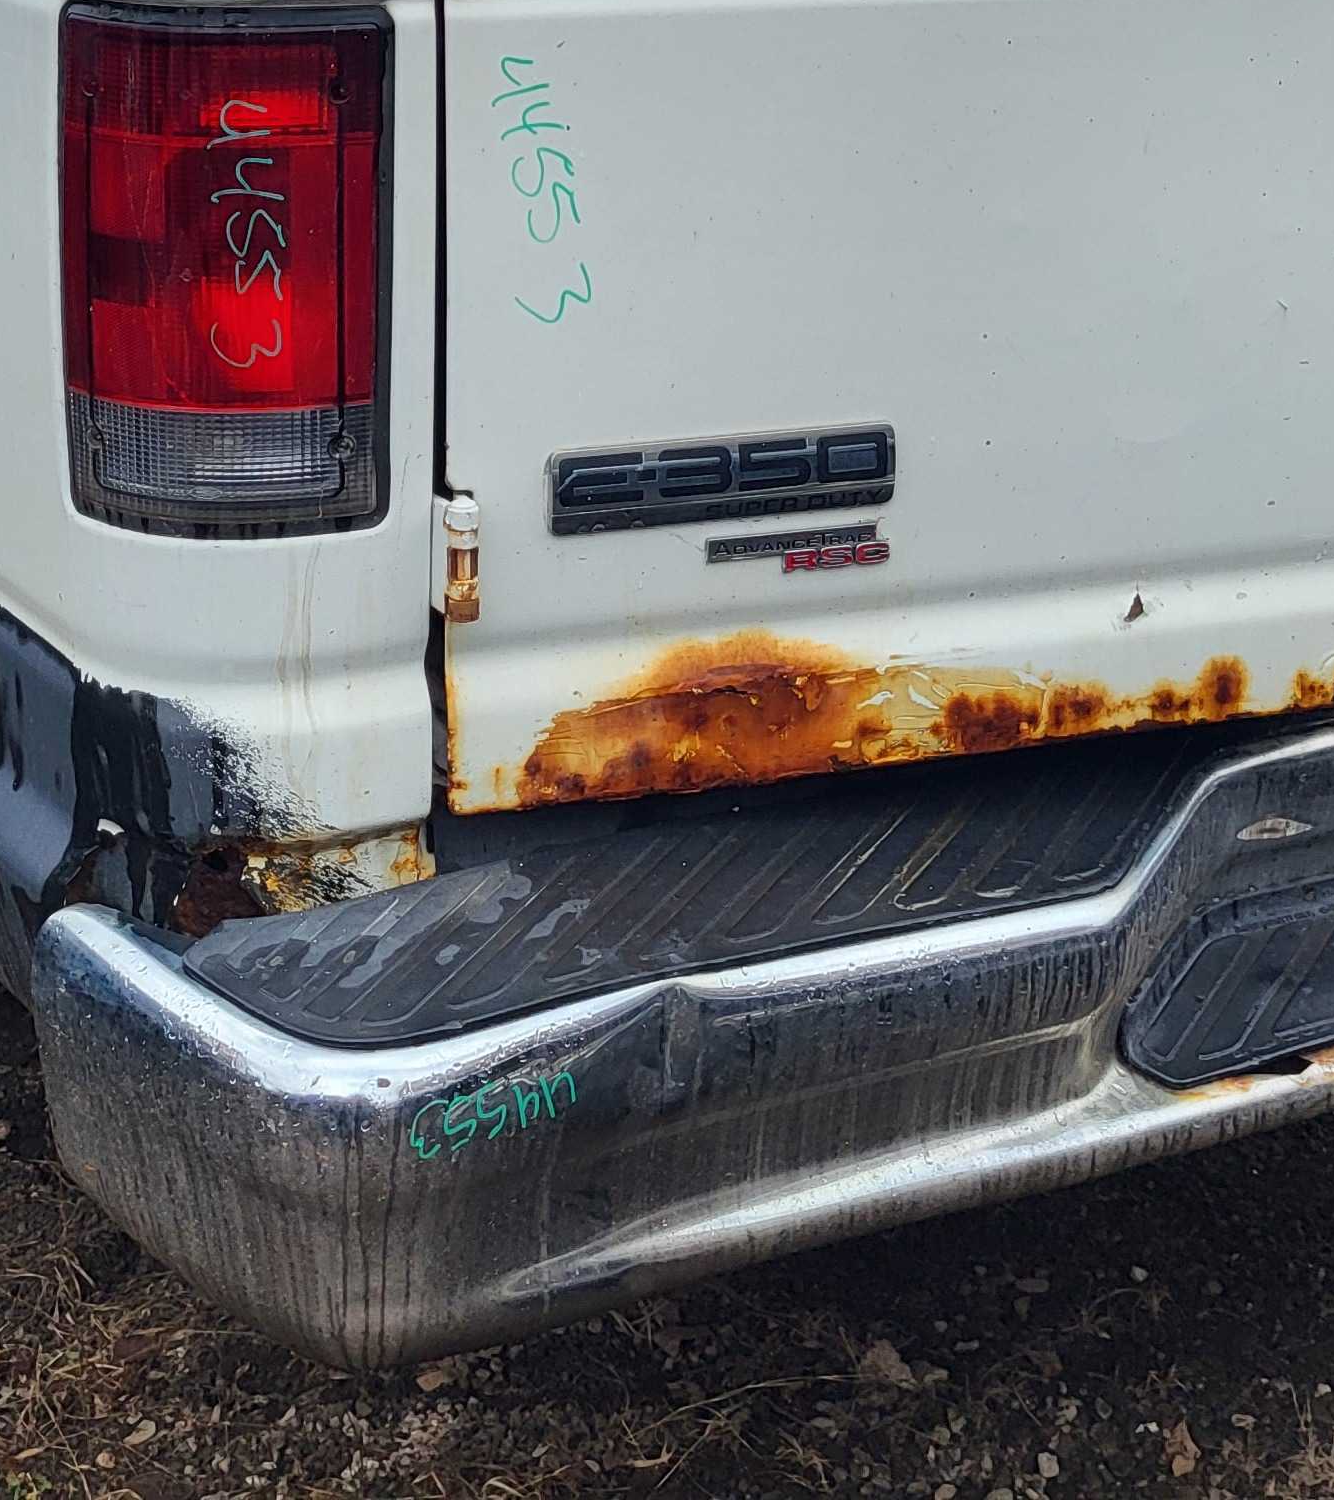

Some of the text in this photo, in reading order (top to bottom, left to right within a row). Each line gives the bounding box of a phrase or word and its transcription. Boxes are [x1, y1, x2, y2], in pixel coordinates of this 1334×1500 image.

[206, 98, 288, 368] 44553
[490, 54, 592, 324] 44553
[781, 540, 891, 574] RSC
